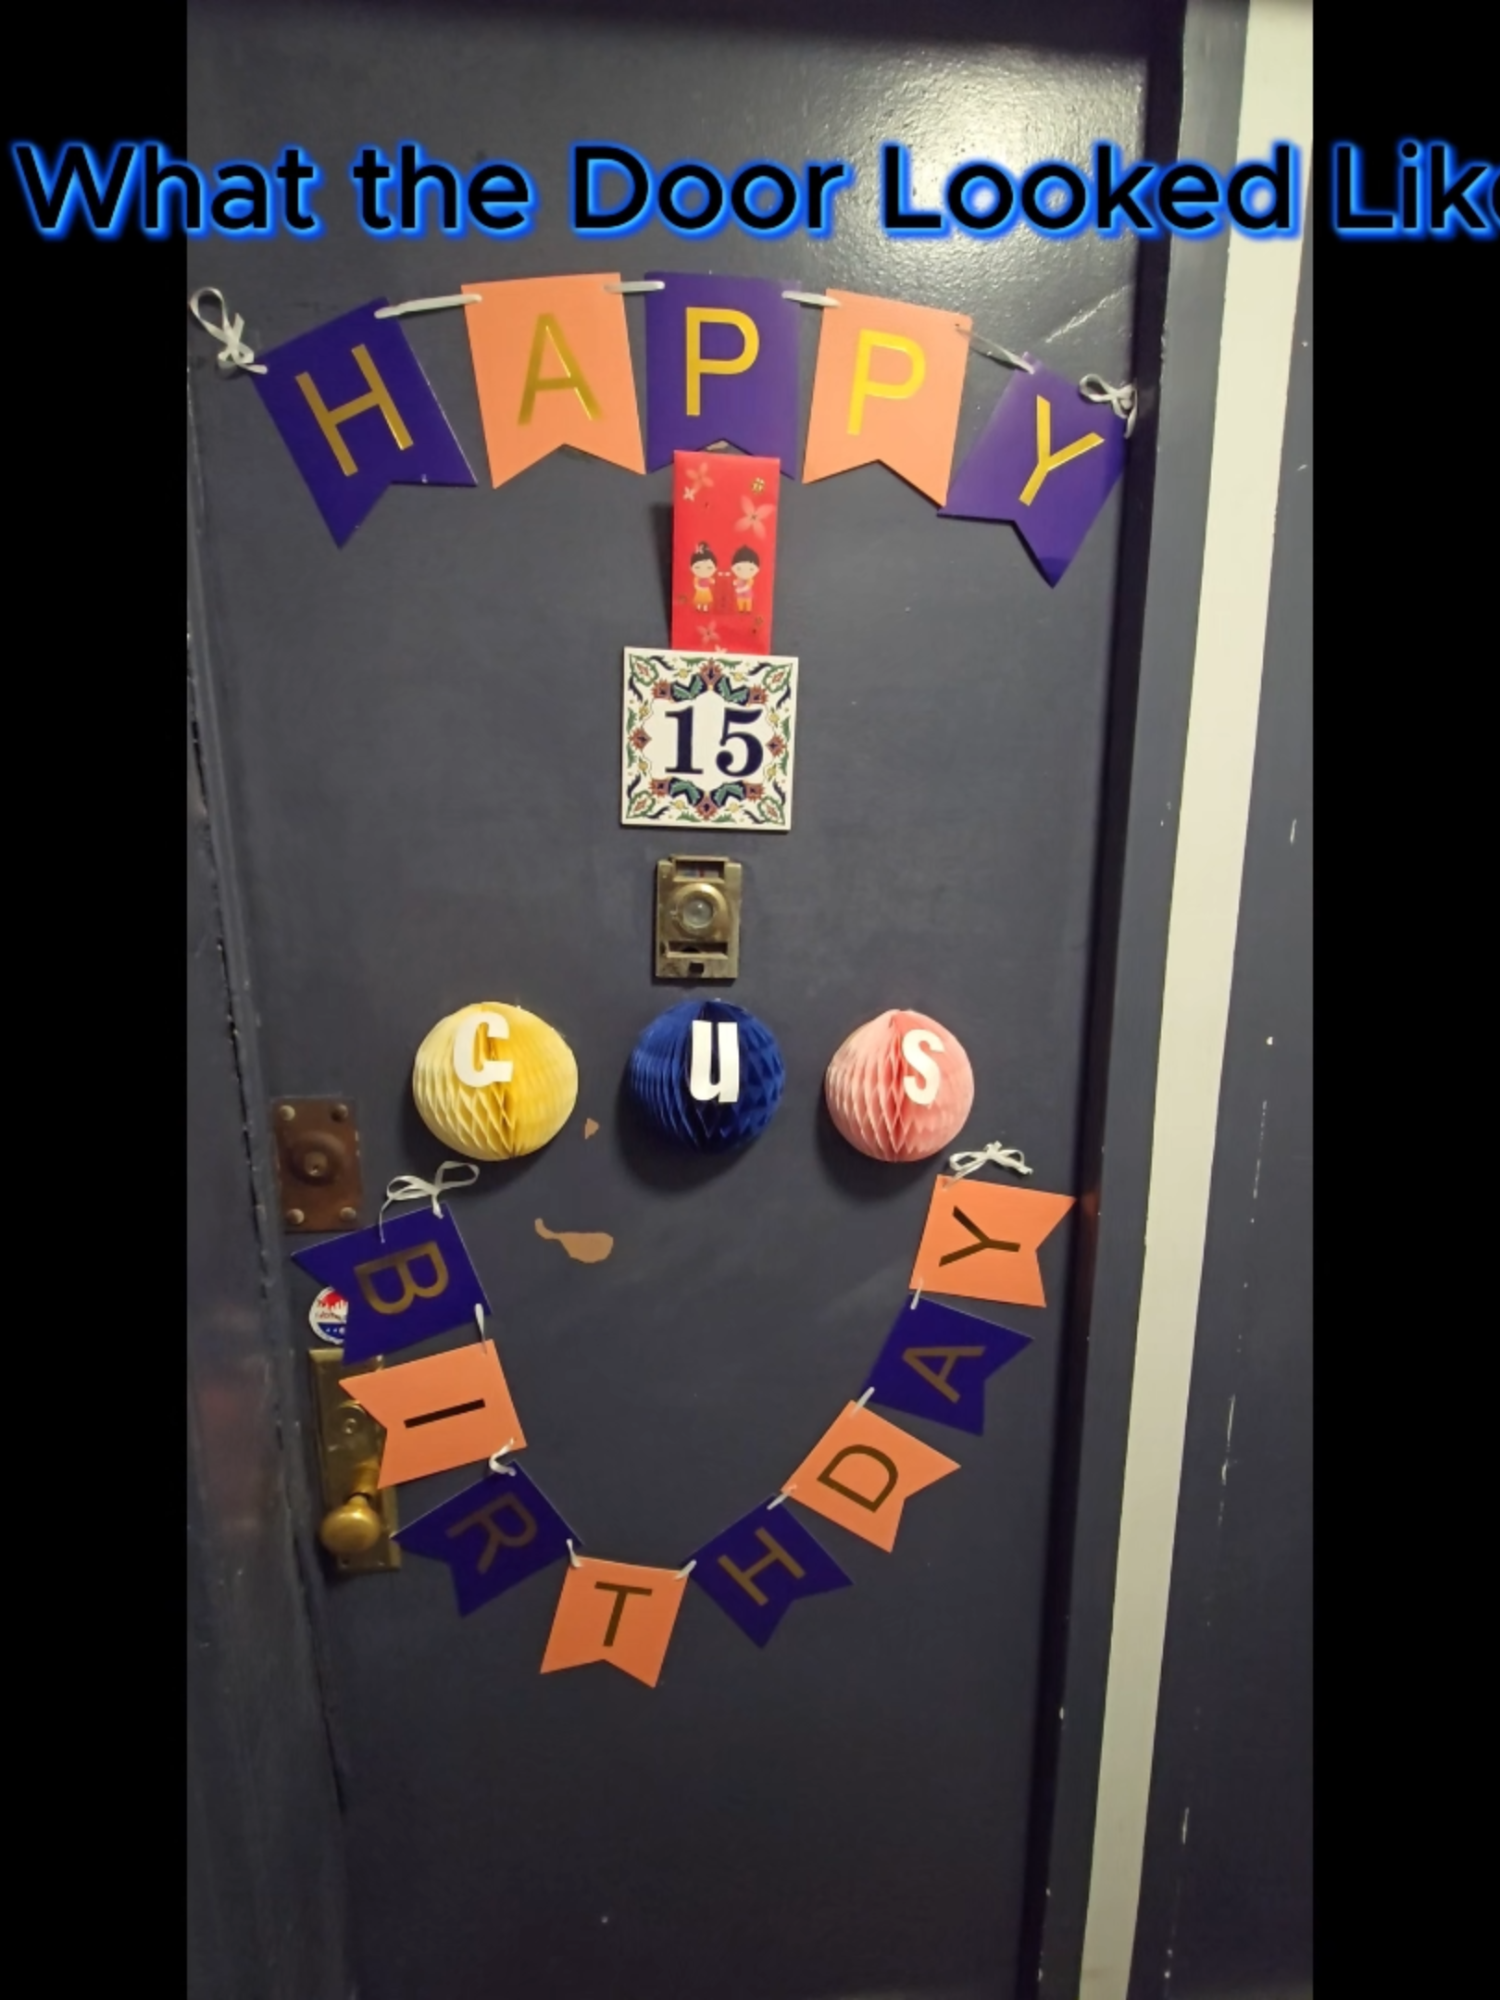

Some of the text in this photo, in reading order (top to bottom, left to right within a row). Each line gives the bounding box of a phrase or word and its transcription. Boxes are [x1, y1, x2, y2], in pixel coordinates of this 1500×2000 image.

[294, 304, 1105, 507] HAPPY
[664, 705, 764, 779] 15
[353, 1204, 1021, 1648] BIRTHDAY
